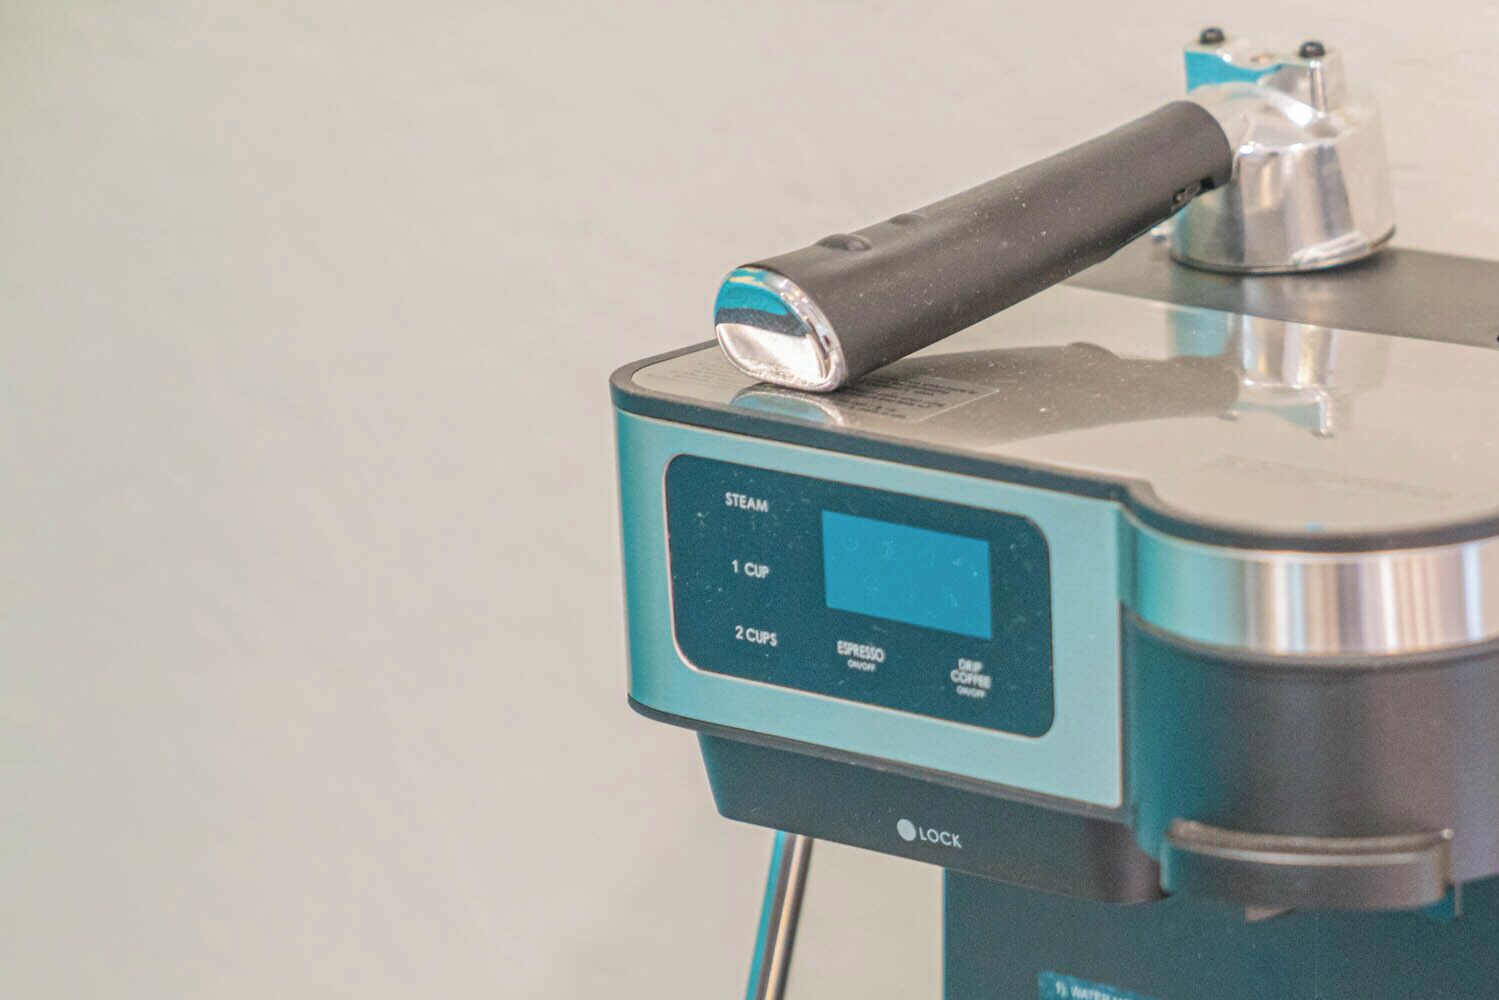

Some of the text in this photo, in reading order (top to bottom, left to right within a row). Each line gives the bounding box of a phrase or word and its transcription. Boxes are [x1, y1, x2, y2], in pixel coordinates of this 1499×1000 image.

[725, 491, 769, 513] STEAM
[731, 560, 769, 579] 1 CUP
[735, 625, 779, 648] 2 CUPS
[836, 639, 886, 663] ESPRESSO
[847, 659, 877, 673] ON/OFF
[957, 657, 984, 673] DRIP
[950, 669, 992, 690] COFFEE
[956, 685, 987, 699] ON/OFF
[918, 826, 963, 848] LOCK
